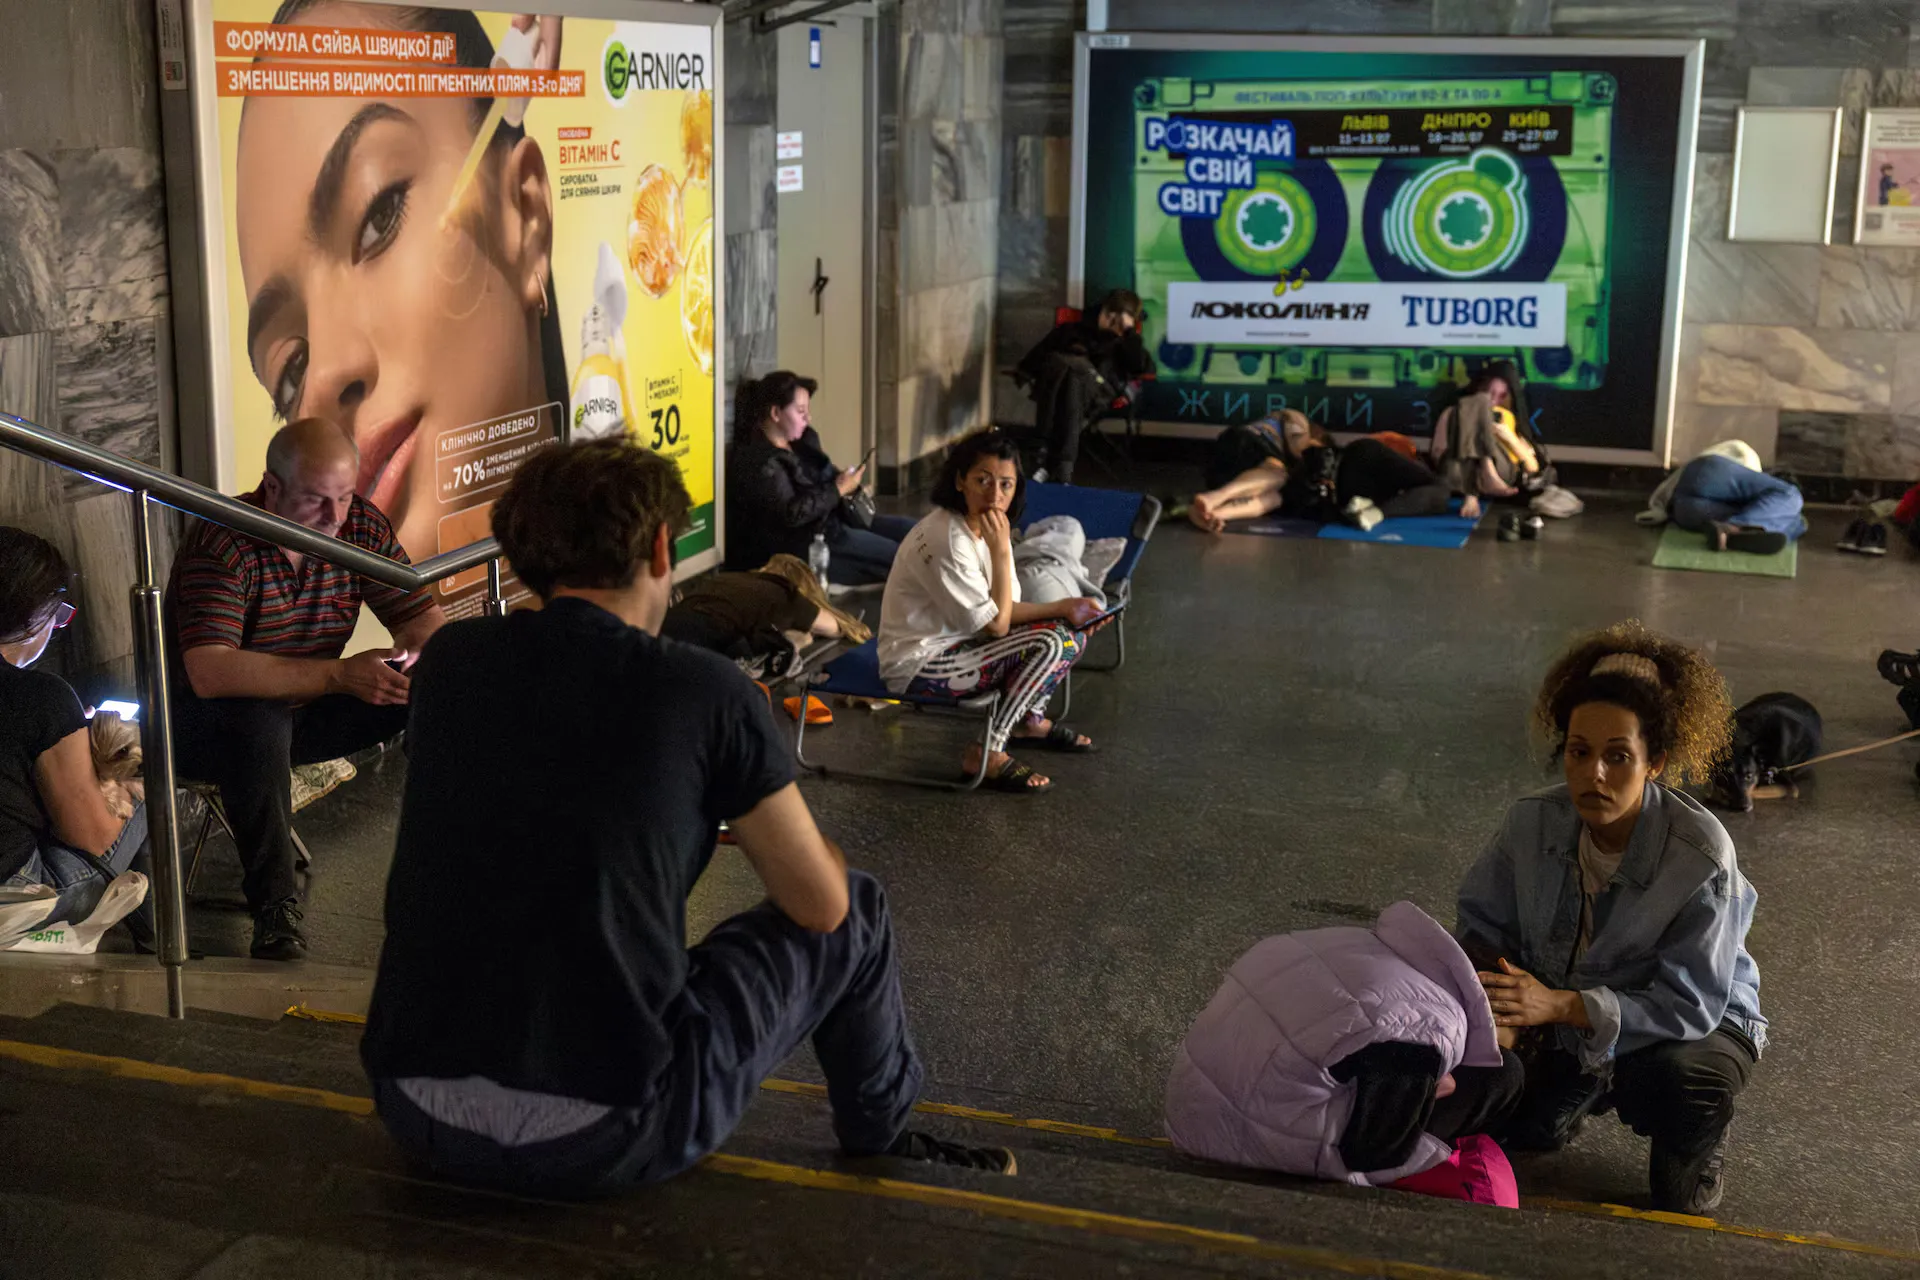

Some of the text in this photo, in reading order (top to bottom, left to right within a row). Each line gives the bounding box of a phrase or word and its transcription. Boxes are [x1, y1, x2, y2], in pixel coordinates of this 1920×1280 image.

[226, 29, 308, 53] ФОРМУЛА
[312, 30, 363, 54] СЯЙВА
[365, 35, 430, 59] ШВИДКОЇ
[228, 70, 330, 91] ЗМЕНШЕННЯ
[334, 72, 415, 94] ВИДИМОСТІ
[418, 73, 495, 92] ПІГМЕНТНИХ
[498, 75, 530, 93] ПЛЯМ
[538, 76, 558, 93] 5-го
[606, 48, 705, 93] GARNIER
[1340, 113, 1390, 131] ЛЬВІВ
[1421, 112, 1493, 131] ДНІПРО
[1508, 109, 1551, 129] КИЇВ
[1147, 121, 1291, 156] РОЗКАЧАЙ
[559, 145, 608, 165] ВІТАМІН
[1187, 154, 1253, 185] СВІЙ
[1161, 186, 1224, 215] СВІТ
[1401, 295, 1538, 329] TUBORG
[1177, 386, 1374, 428] ЖИВИЙ
[441, 415, 536, 452] КЛІНІЧНО ДОВЕДЕНО
[650, 404, 681, 450] 30
[453, 459, 486, 489] 70%
